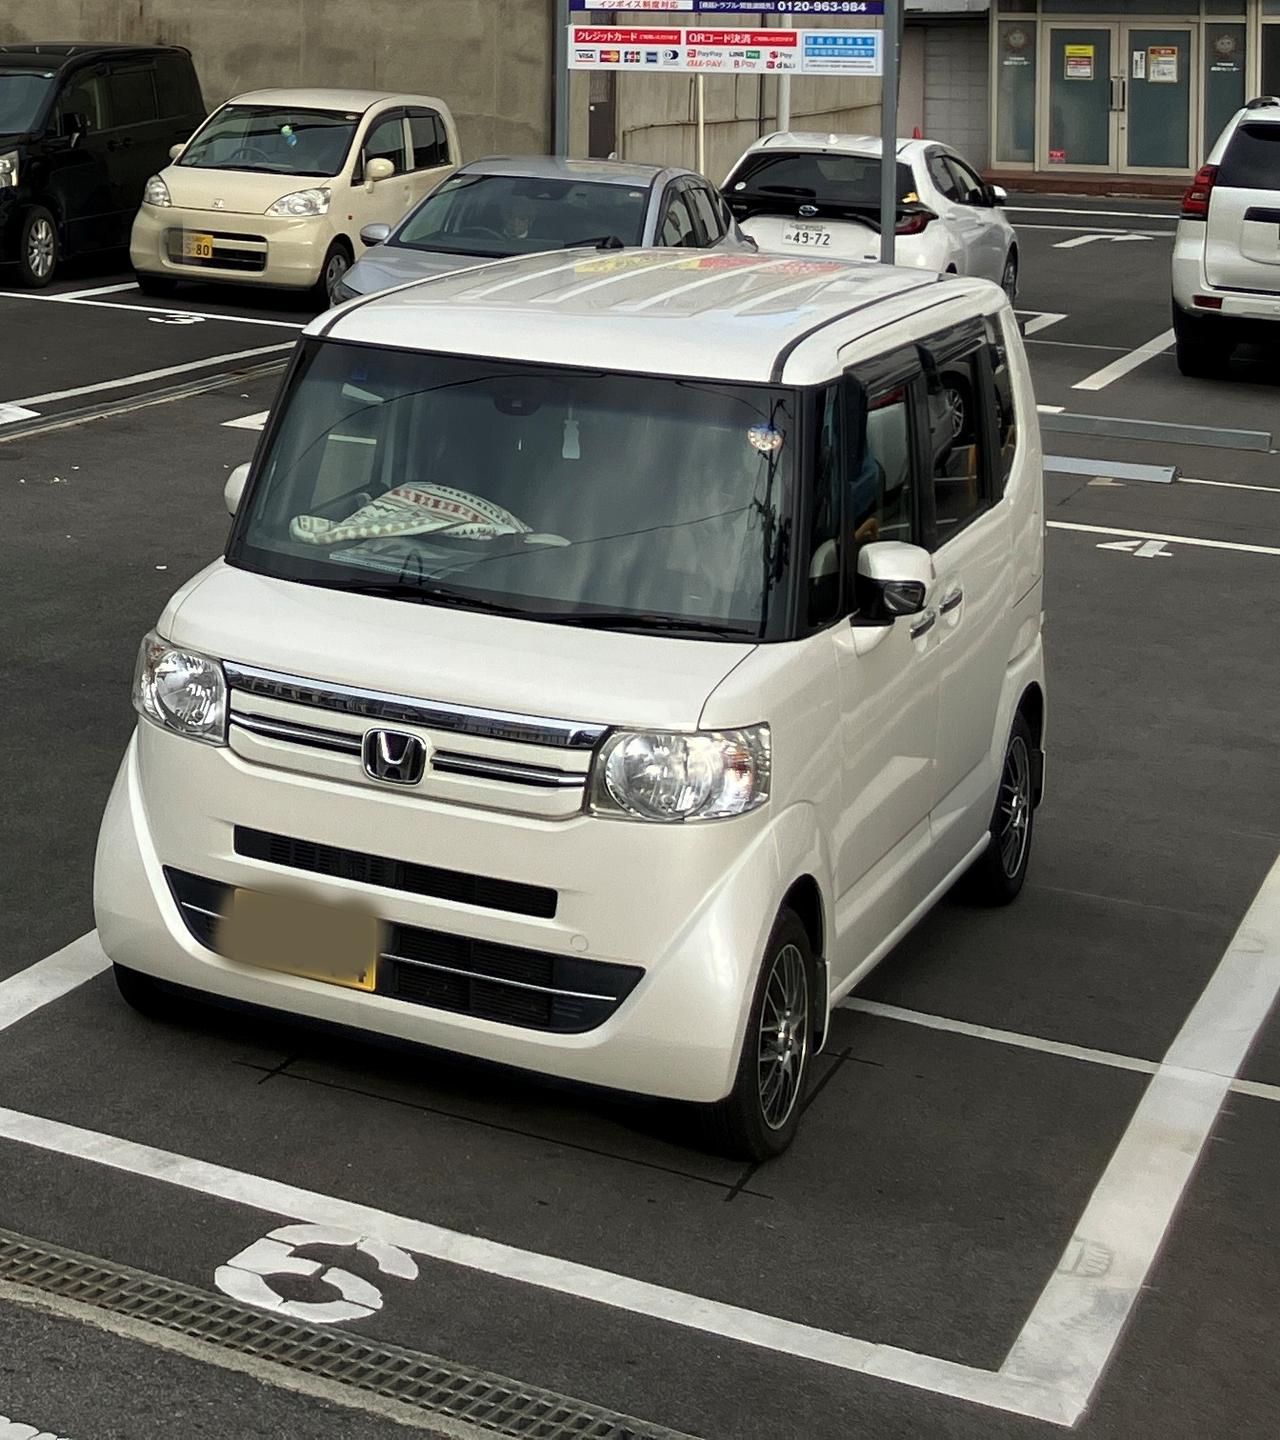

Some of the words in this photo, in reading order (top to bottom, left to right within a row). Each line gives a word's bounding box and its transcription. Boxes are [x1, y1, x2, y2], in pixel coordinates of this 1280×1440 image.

[777, 0, 867, 11] 0120-963-984
[577, 31, 638, 42] クレジットカード
[689, 33, 751, 44] QRコード決済
[697, 50, 722, 58] PayPay
[793, 231, 831, 246] 49-72
[214, 1223, 420, 1324] 6
